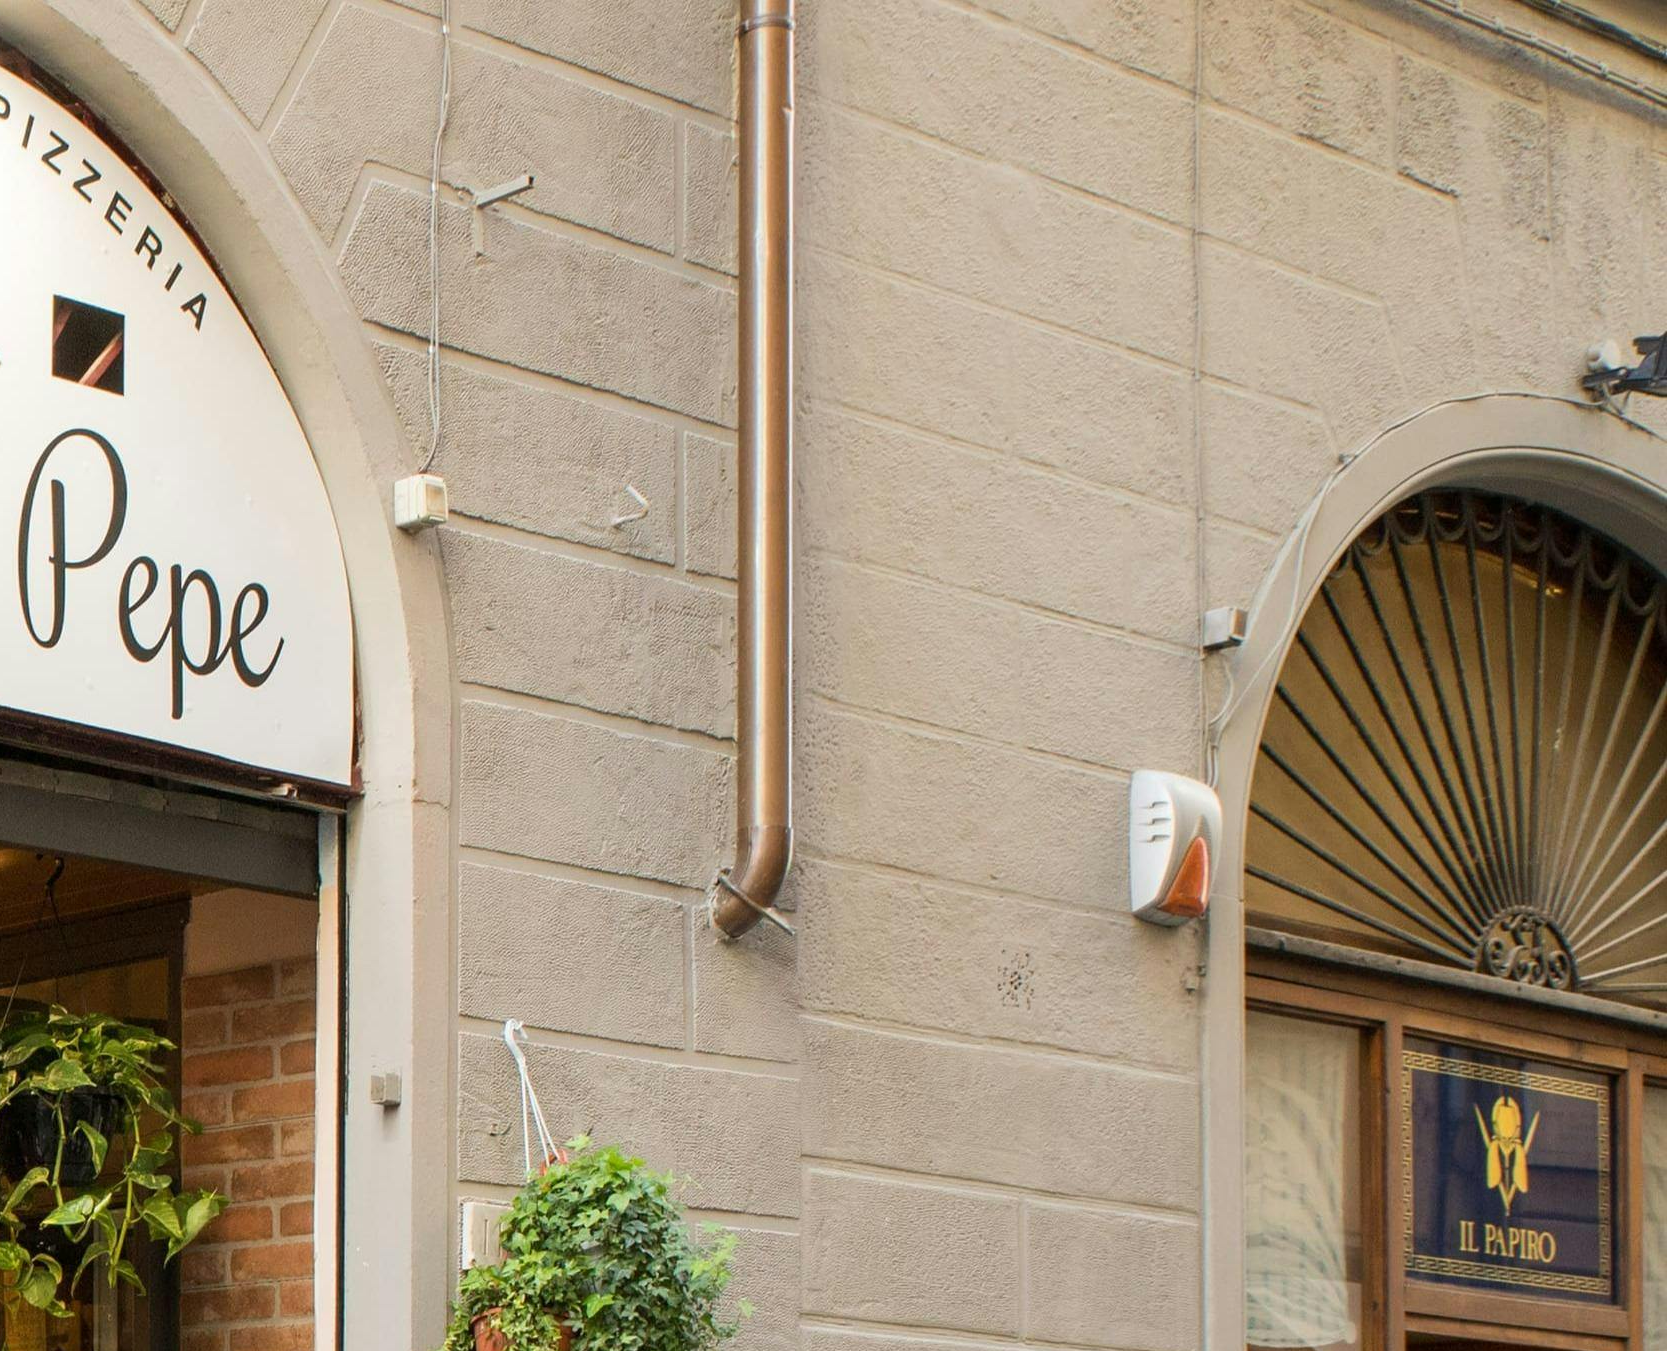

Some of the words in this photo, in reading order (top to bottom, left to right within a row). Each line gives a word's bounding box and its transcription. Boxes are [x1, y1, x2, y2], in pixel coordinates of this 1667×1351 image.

[18, 428, 285, 720] Pepe
[1459, 1220, 1480, 1253] IL
[1484, 1223, 1557, 1264] PAPIRO
